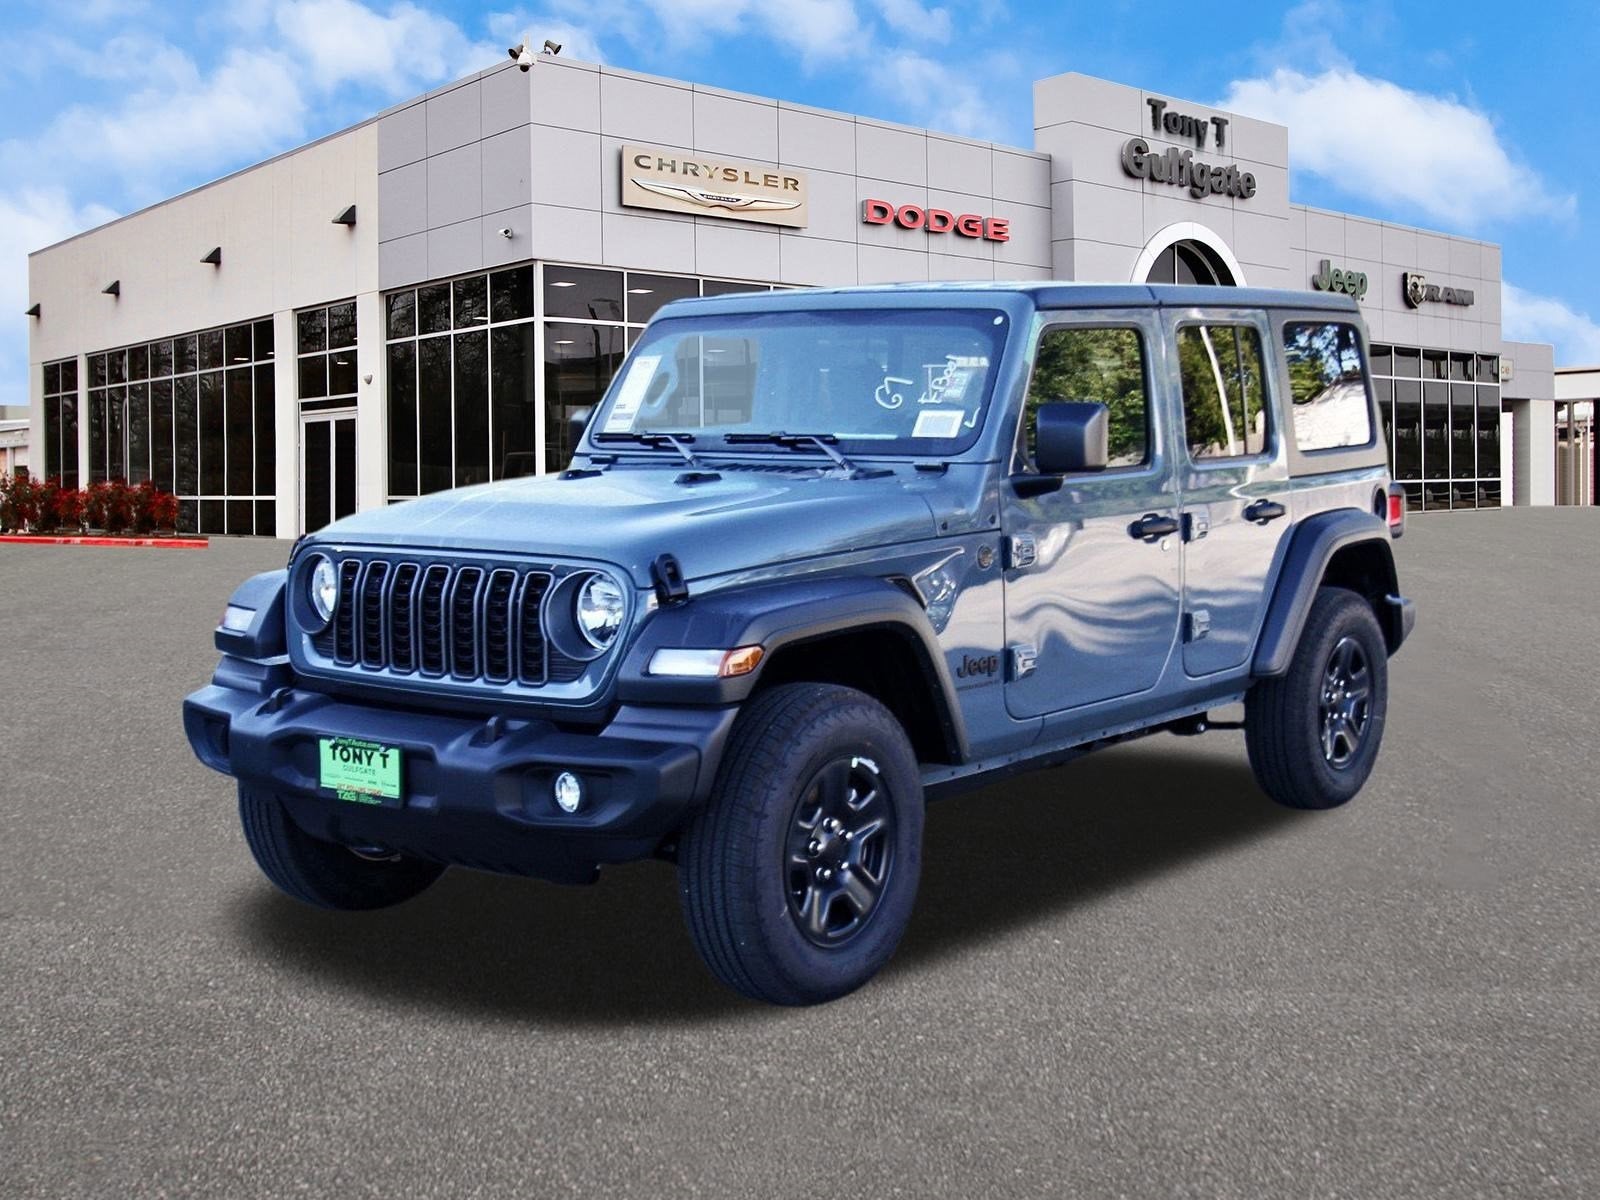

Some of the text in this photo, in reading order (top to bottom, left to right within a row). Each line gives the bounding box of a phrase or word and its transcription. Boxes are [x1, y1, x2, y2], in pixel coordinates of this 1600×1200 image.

[1146, 98, 1229, 148] Tony T
[633, 153, 800, 192] CHRYSLER
[1121, 138, 1256, 199] Gulfgate
[862, 198, 1010, 242] DODGE
[1312, 259, 1368, 297] Jeep
[1424, 283, 1475, 306] RAM
[956, 654, 998, 679] Jeep
[329, 743, 389, 769] TONY T
